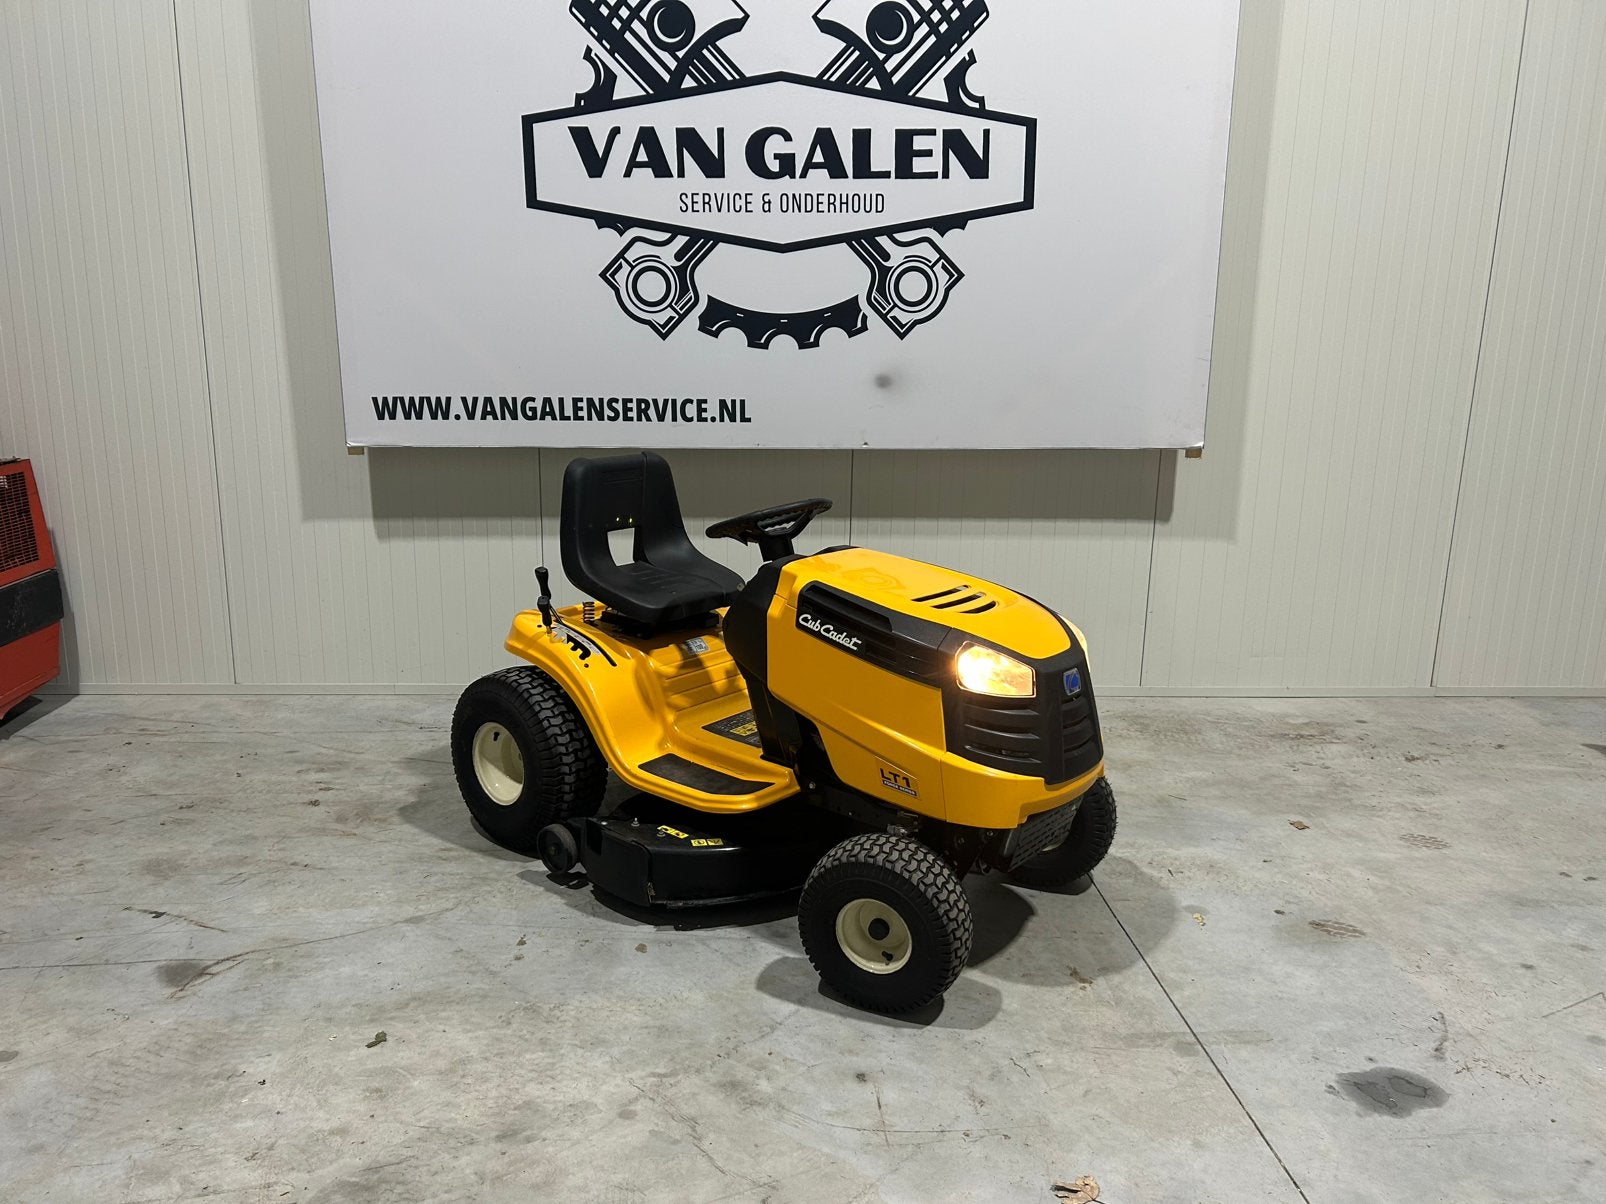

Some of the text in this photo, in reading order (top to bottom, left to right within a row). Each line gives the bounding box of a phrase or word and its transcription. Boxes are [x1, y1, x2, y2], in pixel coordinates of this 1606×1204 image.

[567, 125, 991, 180] VAN GALEN
[679, 192, 885, 214] SERVICE & ONDERHOUD
[371, 396, 752, 423] WWW.VANGALENSERVICE.NL
[798, 613, 862, 650] Cub Cadet
[879, 767, 911, 788] LT1
